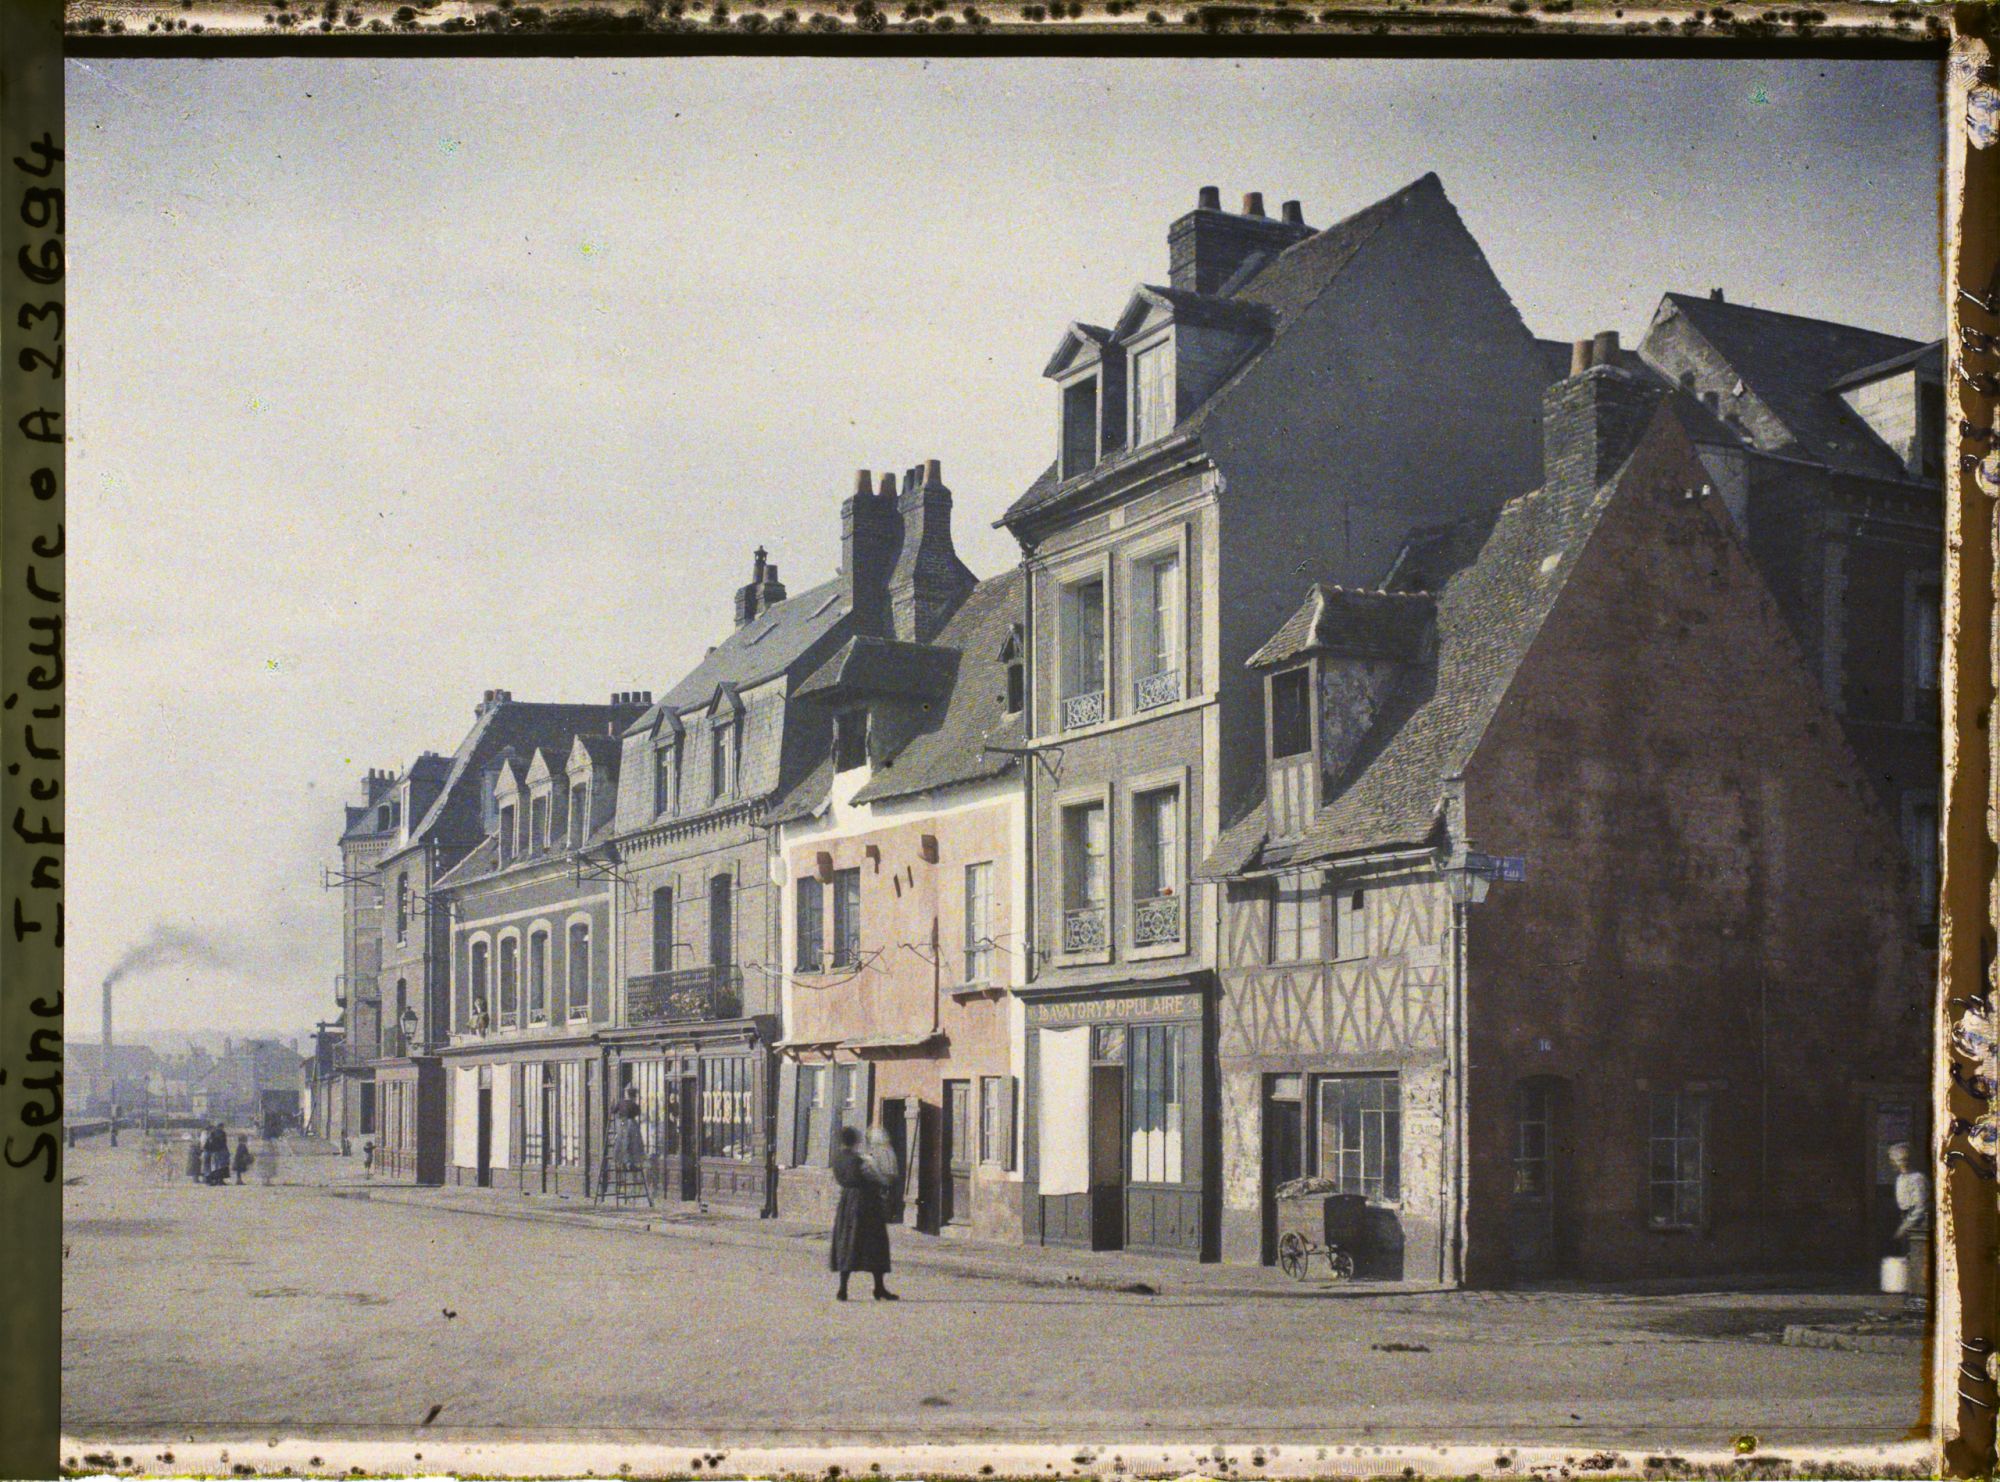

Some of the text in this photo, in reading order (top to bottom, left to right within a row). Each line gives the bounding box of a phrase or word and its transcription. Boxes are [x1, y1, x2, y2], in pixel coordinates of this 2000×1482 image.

[13, 132, 65, 380] 23694
[18, 406, 65, 444] A
[1104, 995, 1185, 1018] POPULAIRE
[0, 990, 64, 1184] Seine
